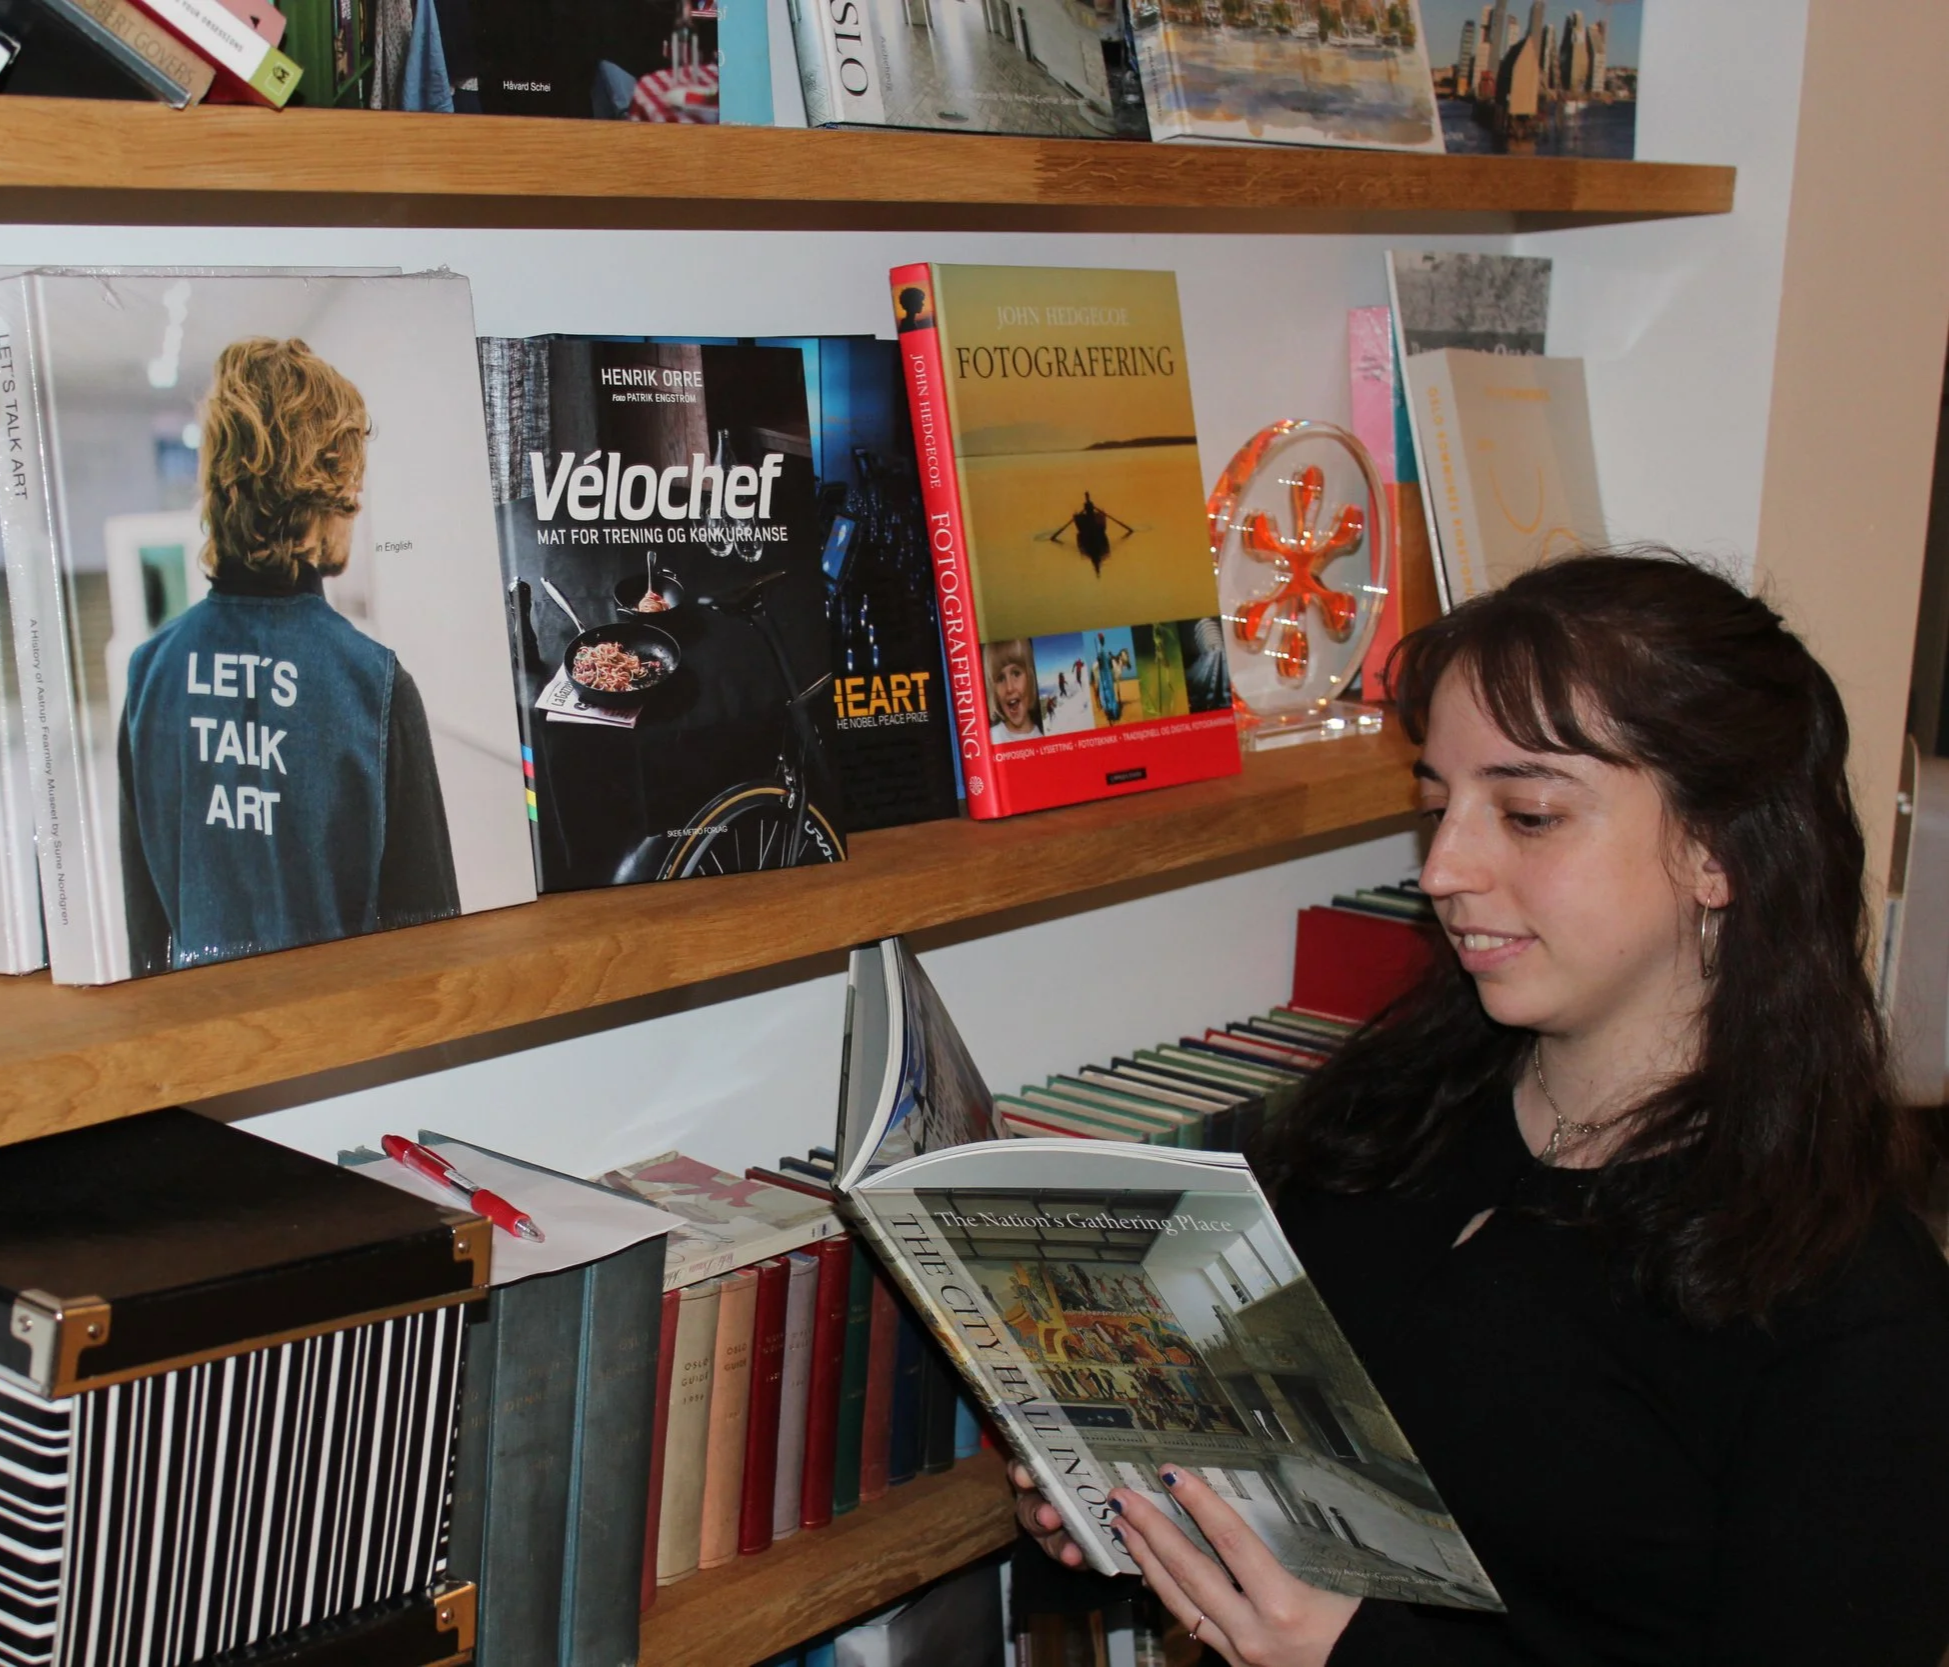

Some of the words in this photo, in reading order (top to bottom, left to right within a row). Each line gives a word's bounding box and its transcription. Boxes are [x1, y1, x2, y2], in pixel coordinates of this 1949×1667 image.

[134, 25, 197, 87] GOVERS
[830, 0, 869, 97] SLO
[502, 79, 529, 93] Håvard
[530, 81, 551, 93] Schei
[997, 306, 1041, 329] JOHN
[1046, 306, 1129, 327] HEDGECOE
[601, 368, 658, 387] HENRIK
[662, 370, 703, 388] ORRE
[956, 346, 1174, 379] FOTOGRAFERING
[626, 393, 653, 403] PATRIK
[5, 399, 25, 453] TALK
[11, 459, 28, 502] ART
[529, 450, 784, 522] Vélochef
[375, 542, 383, 553] in
[385, 540, 413, 554] English
[537, 529, 567, 545] MAT
[571, 529, 599, 545] FOR
[602, 528, 664, 545] TRENING
[667, 528, 687, 544] OG
[689, 526, 788, 543] KONKURRANSE
[911, 355, 928, 396] JOHN
[920, 402, 942, 489] HEDGECOE
[931, 511, 981, 760] FOTOGRAFERING
[30, 618, 37, 628] A
[30, 629, 41, 669] History
[35, 672, 43, 686] of
[187, 652, 298, 707] LET'S
[36, 686, 48, 723] Astrup
[836, 719, 849, 731] HE
[850, 717, 878, 729] NOBEL
[879, 714, 905, 727] PEACE
[906, 711, 929, 725] PRIZE
[40, 726, 53, 775] Fearnley
[190, 717, 287, 775] TALK
[46, 778, 58, 822] Museet
[206, 784, 281, 835] ART
[51, 823, 61, 838] by
[53, 839, 63, 870] Sune
[56, 873, 69, 925] Nordgren
[934, 1212, 978, 1230] The
[981, 1212, 1063, 1230] Nation's
[1067, 1212, 1178, 1236] Gathering
[1179, 1214, 1233, 1233] Place
[726, 1343, 747, 1355] OSLO
[891, 1212, 955, 1277] THE
[940, 1284, 1010, 1358] CITY
[993, 1363, 1066, 1440] HALL
[1047, 1445, 1091, 1478] IN
[684, 1356, 709, 1372] OSLO
